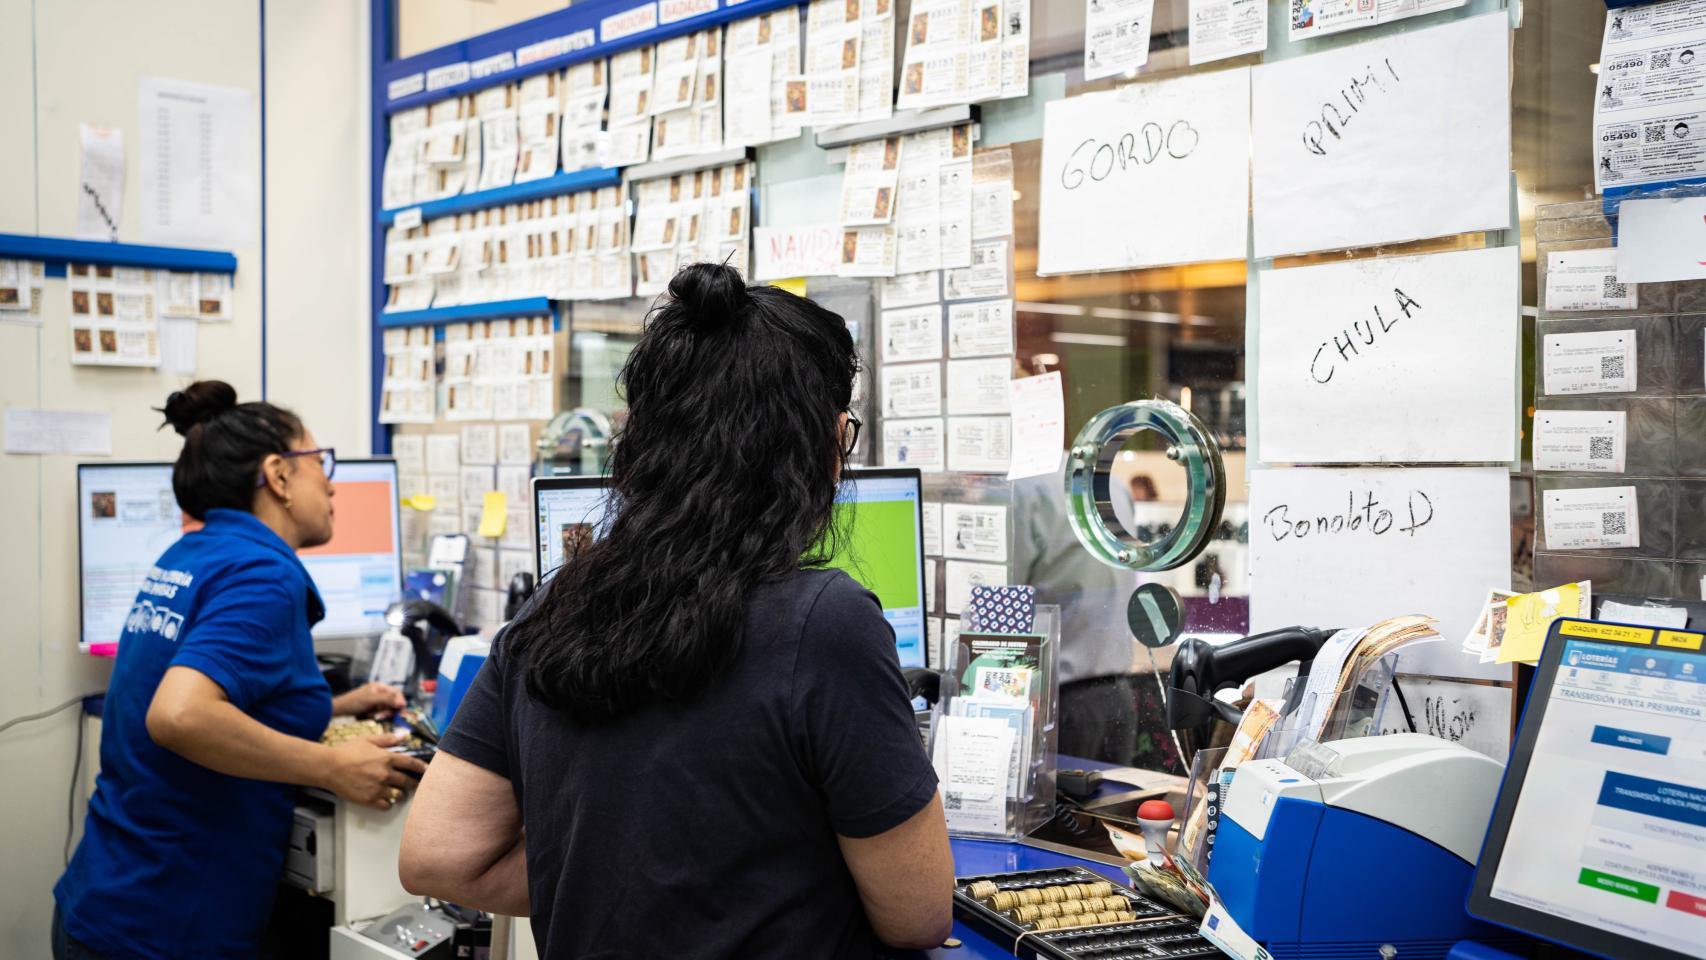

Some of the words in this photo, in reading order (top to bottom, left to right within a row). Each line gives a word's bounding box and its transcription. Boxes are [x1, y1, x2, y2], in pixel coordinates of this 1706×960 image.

[1608, 60, 1644, 71] 05490
[1302, 58, 1400, 156] PRIMI
[1061, 119, 1200, 191] GORDO
[1602, 131, 1638, 142] 05490
[1310, 287, 1422, 386] CHULA
[1560, 688, 1616, 705] TRANSMISIÓN
[1617, 697, 1645, 708] VENTA
[1647, 701, 1702, 717] PREIMPRESA
